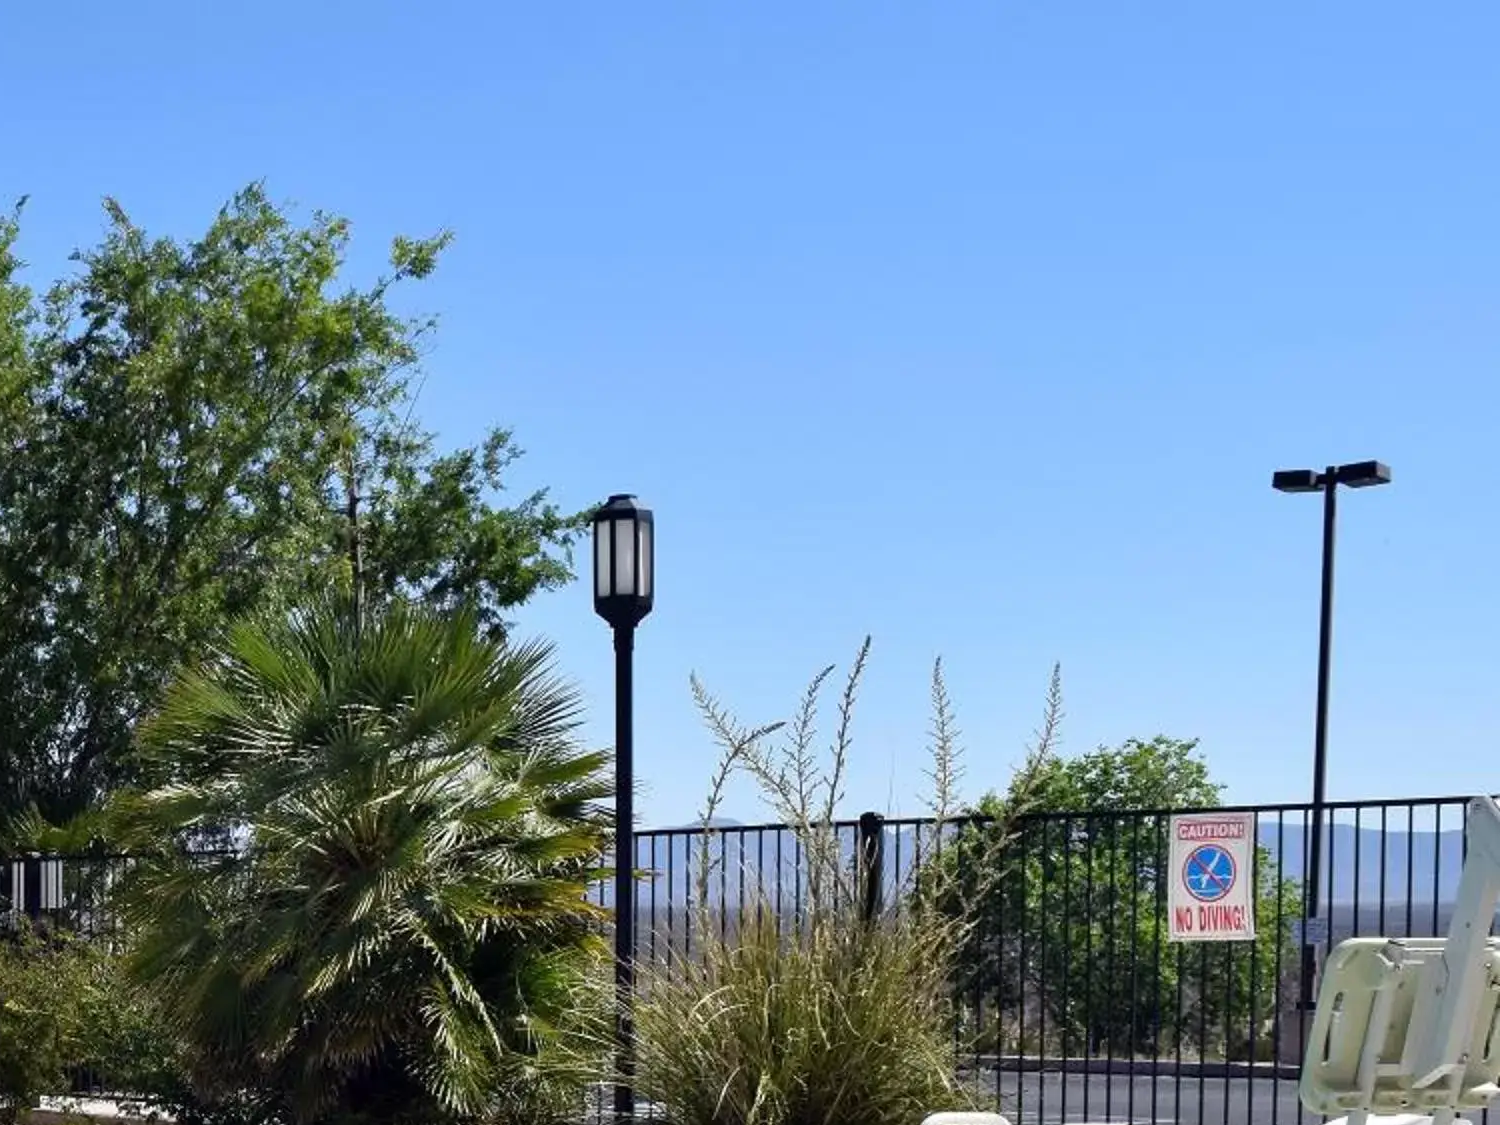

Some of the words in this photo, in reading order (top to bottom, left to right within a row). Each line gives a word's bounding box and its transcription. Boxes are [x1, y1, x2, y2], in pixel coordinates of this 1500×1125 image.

[1178, 822, 1244, 840] CAUTION!
[1175, 906, 1193, 932] NO
[1199, 905, 1246, 932] DIVING!
